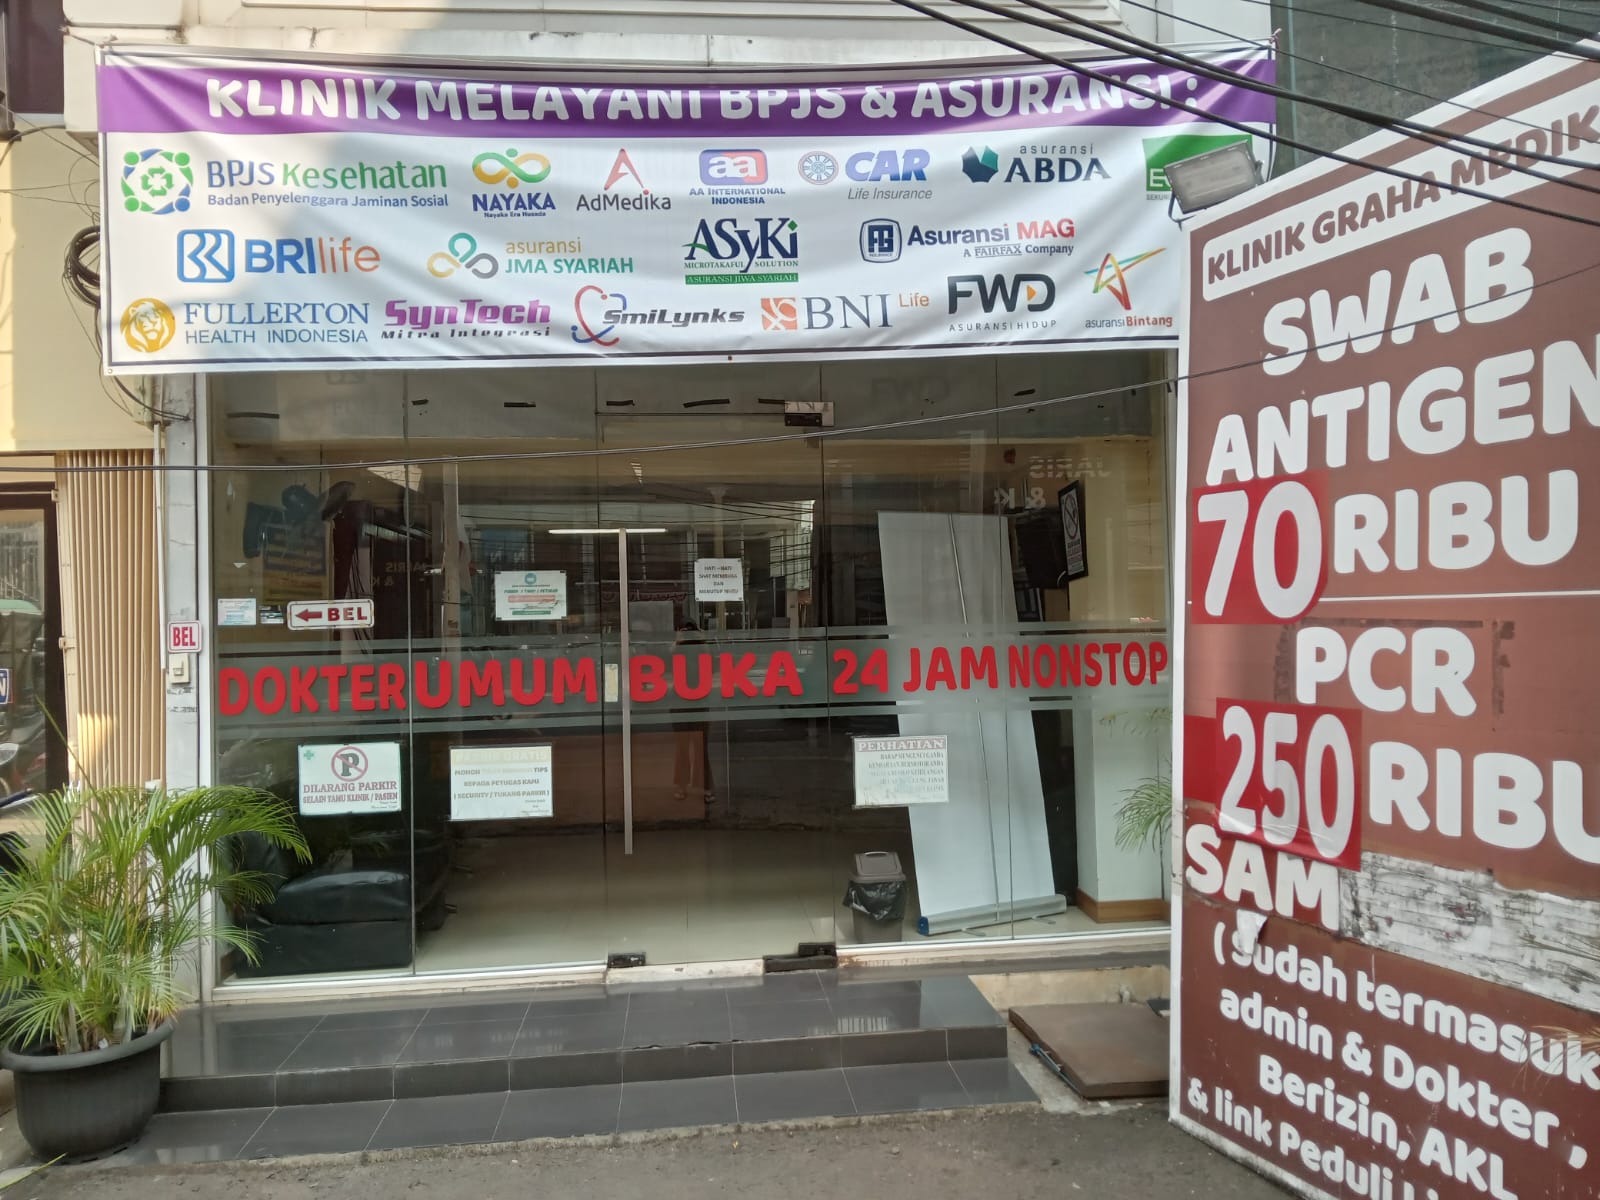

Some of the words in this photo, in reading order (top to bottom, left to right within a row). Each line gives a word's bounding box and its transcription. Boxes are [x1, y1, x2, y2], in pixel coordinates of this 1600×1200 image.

[206, 78, 400, 120] KLINIK
[416, 80, 701, 121] MELAYANI
[720, 87, 846, 119] BPJS
[860, 86, 898, 118] &
[911, 75, 1170, 118] ASURANSI
[1020, 143, 1094, 156] asuransi
[207, 160, 275, 188] BPJS
[283, 160, 448, 190] Kesehatan
[708, 156, 757, 178] aa
[845, 148, 930, 182] CAR
[1004, 158, 1112, 183] ABDA
[208, 194, 248, 206] Badan
[252, 193, 348, 208] Penyelenggara
[352, 195, 408, 208] Jaminan
[411, 194, 449, 208] Sosial
[472, 192, 556, 212] NAYAKA
[576, 189, 672, 211] AdMedika
[708, 188, 786, 196] INTERNATIONAL
[712, 196, 766, 204] INDONESIA
[848, 188, 870, 200] Life
[873, 187, 932, 200] Insurance
[908, 223, 1010, 246] Asuransi
[1016, 218, 1075, 240] MAG
[1208, 222, 1304, 284] KLINIK
[1312, 172, 1442, 244] GRAHA
[506, 237, 582, 254] asuransi
[964, 248, 971, 258] A
[975, 245, 1022, 257] FAIRFAX
[1026, 244, 1074, 256] Company
[505, 258, 548, 274] JMA
[553, 257, 634, 274] SYARIAH
[687, 276, 732, 284] ASURANSI
[734, 275, 756, 284] JIWA
[758, 274, 797, 282] SYARIAH
[947, 274, 1056, 314] FWD
[1262, 227, 1534, 376] SWAB
[184, 302, 370, 325] FULLERTON
[384, 299, 551, 330] SynTech
[802, 294, 893, 330] BNI
[899, 292, 930, 308] Life
[186, 330, 256, 344] HEALTH
[267, 329, 368, 344] INDONESIA
[949, 322, 1012, 332] ASURANSI
[1016, 320, 1058, 330] HIDUP
[1206, 333, 1600, 486] ANTIGEN
[1198, 480, 1322, 618] 70
[1334, 469, 1579, 574] RIBU
[328, 607, 368, 622] BEL
[172, 626, 196, 646] BEL
[218, 663, 406, 716] DOKTER
[414, 657, 598, 708] UMUM
[629, 650, 804, 702] BUKA
[832, 648, 890, 696] 24
[902, 646, 998, 692] JAM
[1008, 641, 1169, 688] NONSTOP
[1296, 626, 1477, 717] PCR
[858, 740, 944, 751] PERHATIAN
[304, 783, 355, 793] DILARANG
[358, 781, 398, 790] PARKIR
[1218, 705, 1355, 858] 250
[304, 794, 326, 804] SELAIN
[328, 794, 346, 803] TAMU
[347, 794, 369, 802] KLINIK
[375, 792, 398, 800] PASIEN
[1356, 970, 1600, 1090] termasuk
[1220, 988, 1332, 1060] admin
[1342, 1032, 1373, 1077] &
[1384, 1045, 1560, 1148] Dokter
[1260, 1054, 1410, 1160] Berizin,
[1188, 1077, 1208, 1114] &
[1214, 1086, 1272, 1148] link
[1280, 1122, 1394, 1200] Peduli
